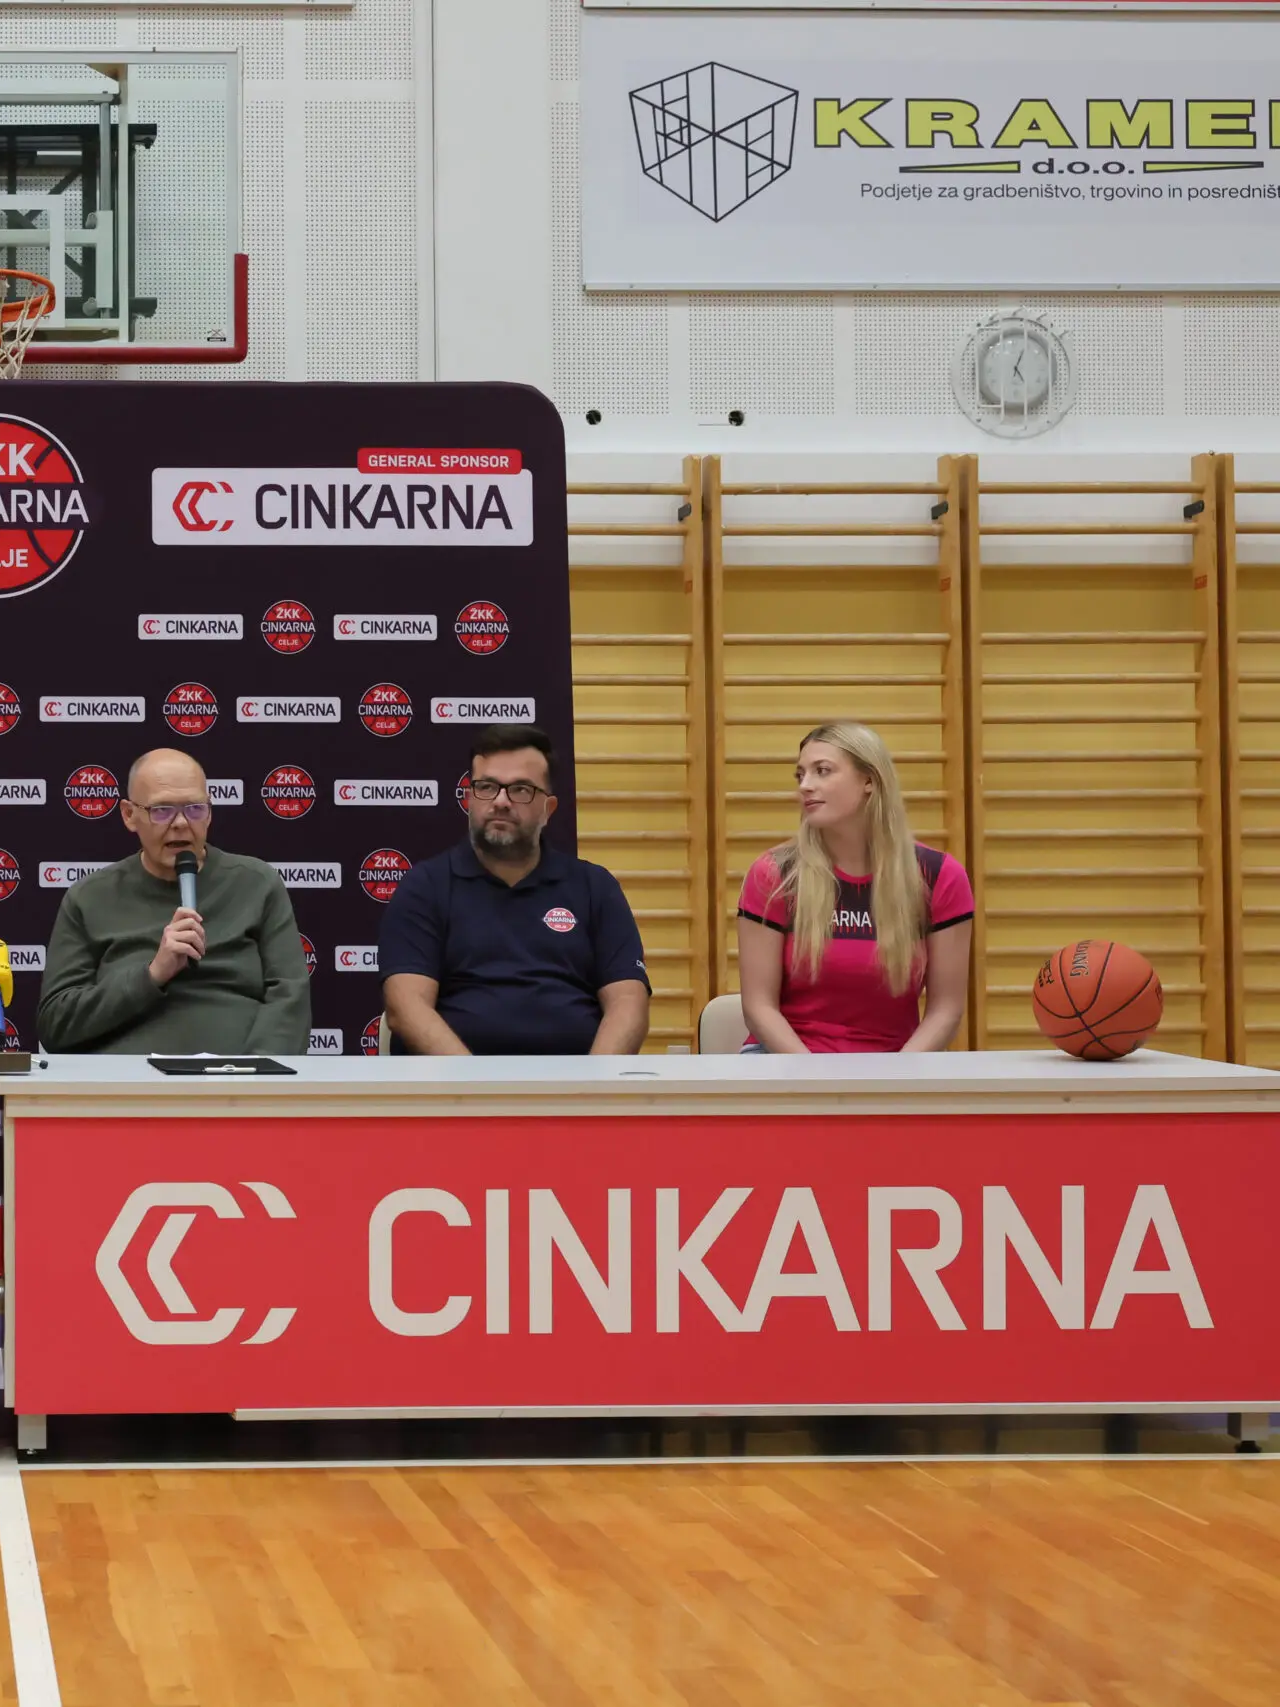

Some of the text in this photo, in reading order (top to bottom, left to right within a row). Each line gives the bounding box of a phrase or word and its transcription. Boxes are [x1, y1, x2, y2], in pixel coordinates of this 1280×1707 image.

[813, 98, 1280, 150] KRAME
[1031, 157, 1135, 174] d.o.o.
[860, 183, 933, 201] Podjetje
[937, 186, 959, 199] za
[962, 183, 1086, 202] gradbeništvo,
[1089, 183, 1163, 202] trgovino
[1168, 184, 1183, 199] in
[368, 454, 509, 469] GENERAL SPONSOR
[255, 483, 514, 530] CINKARNA
[165, 620, 239, 634] CINKARNA
[260, 621, 317, 633] CINKARNA
[360, 620, 433, 635] CINKARNA
[454, 622, 510, 634] CINKARNA
[67, 702, 141, 717] CINKARNA
[162, 703, 219, 715] CINKARNA
[263, 702, 337, 717] CINKARNA
[358, 704, 414, 716] CINKARNA
[457, 703, 531, 718] CINKARNA
[63, 786, 121, 798] CINKARNA
[260, 786, 317, 798] CINKARNA
[361, 785, 434, 800] CINKARNA
[359, 869, 407, 881] CINKARN
[368, 1184, 1214, 1337] CINKARNA
